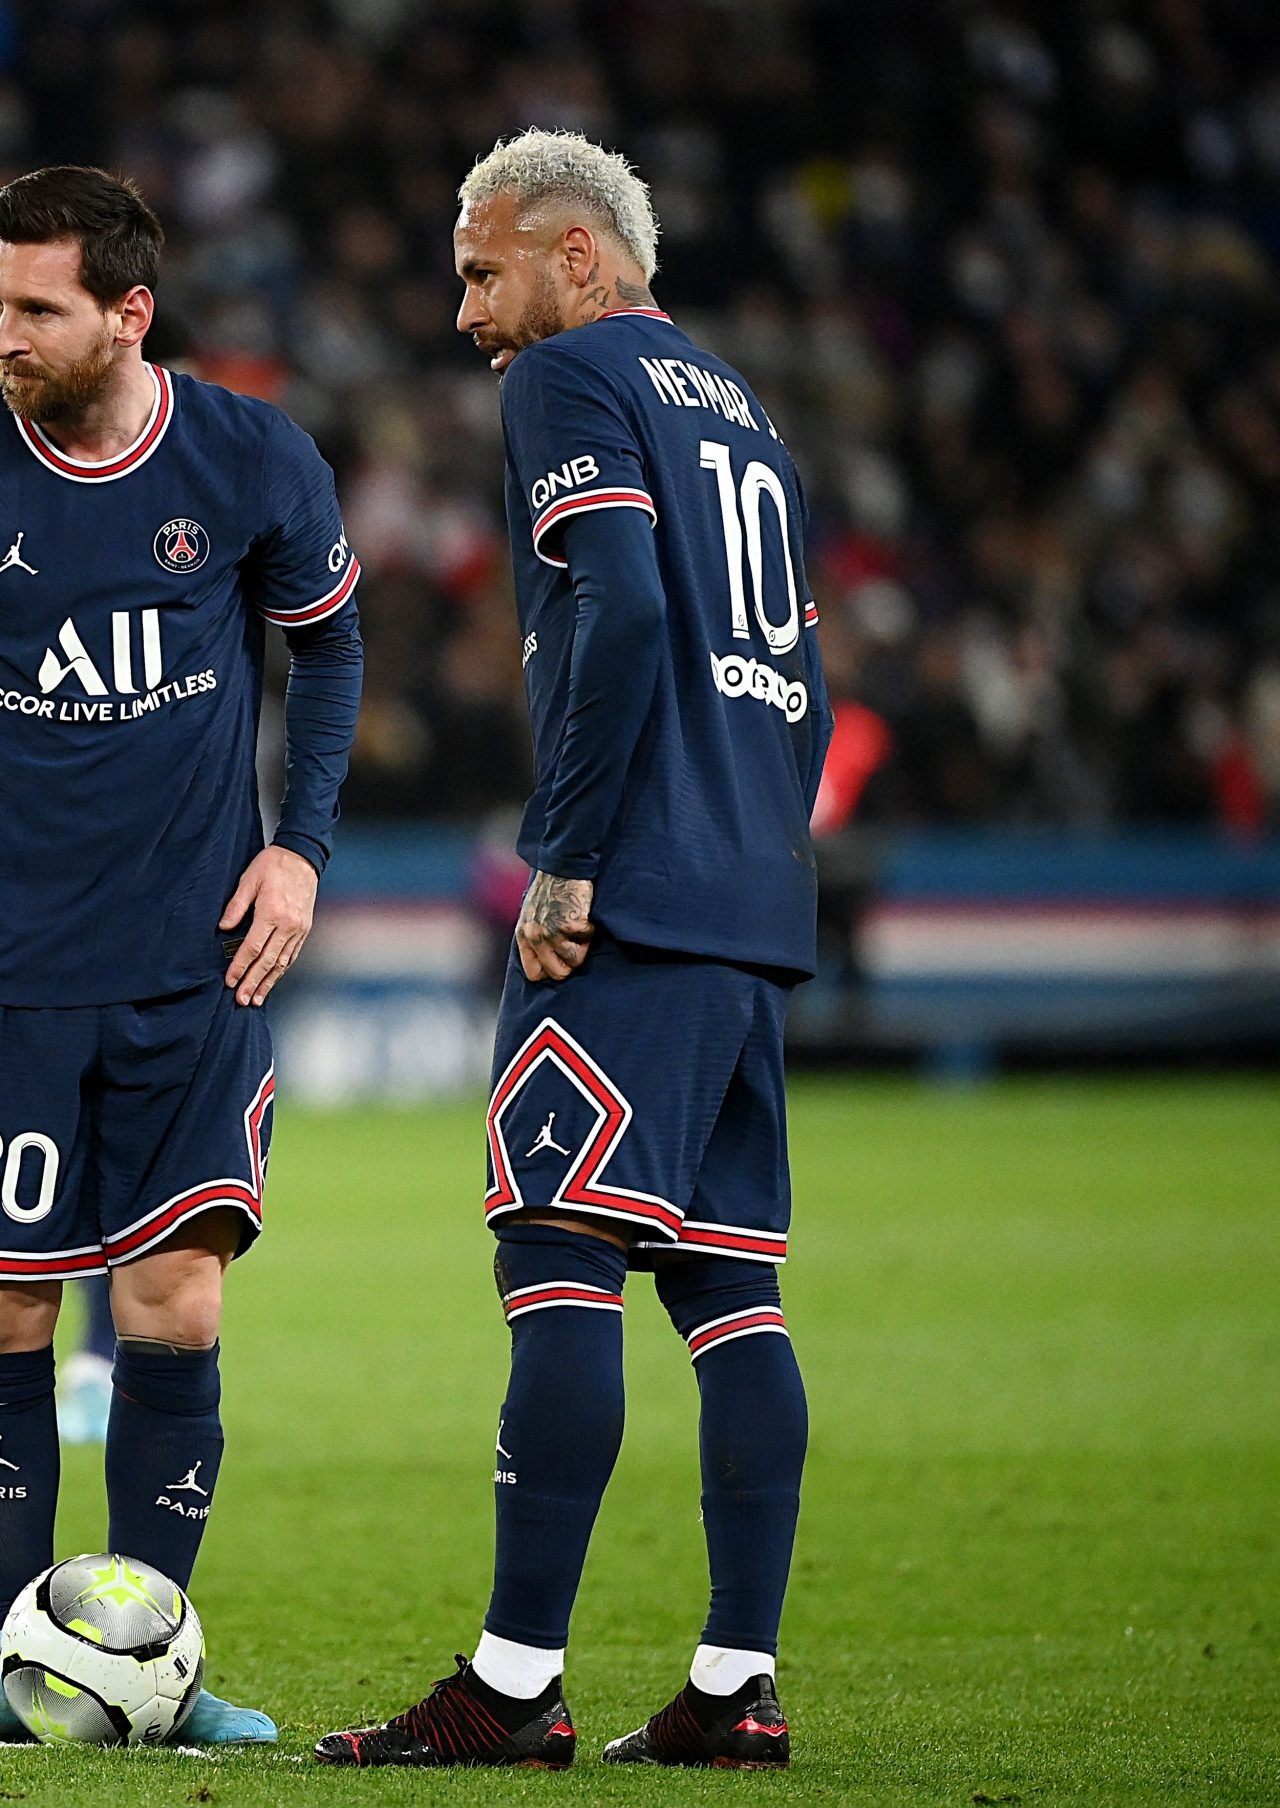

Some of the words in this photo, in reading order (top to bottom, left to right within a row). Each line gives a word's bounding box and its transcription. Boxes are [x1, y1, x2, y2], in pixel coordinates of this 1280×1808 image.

[639, 356, 760, 431] NEYMAR
[531, 454, 600, 509] QNB
[162, 521, 200, 536] PARIS
[328, 523, 349, 573] QN
[699, 440, 799, 655] 10
[59, 701, 114, 722] LIVE
[119, 668, 218, 721] LIMITLESS
[494, 1470, 517, 1484] RIS
[155, 1495, 211, 1520] PARIS
